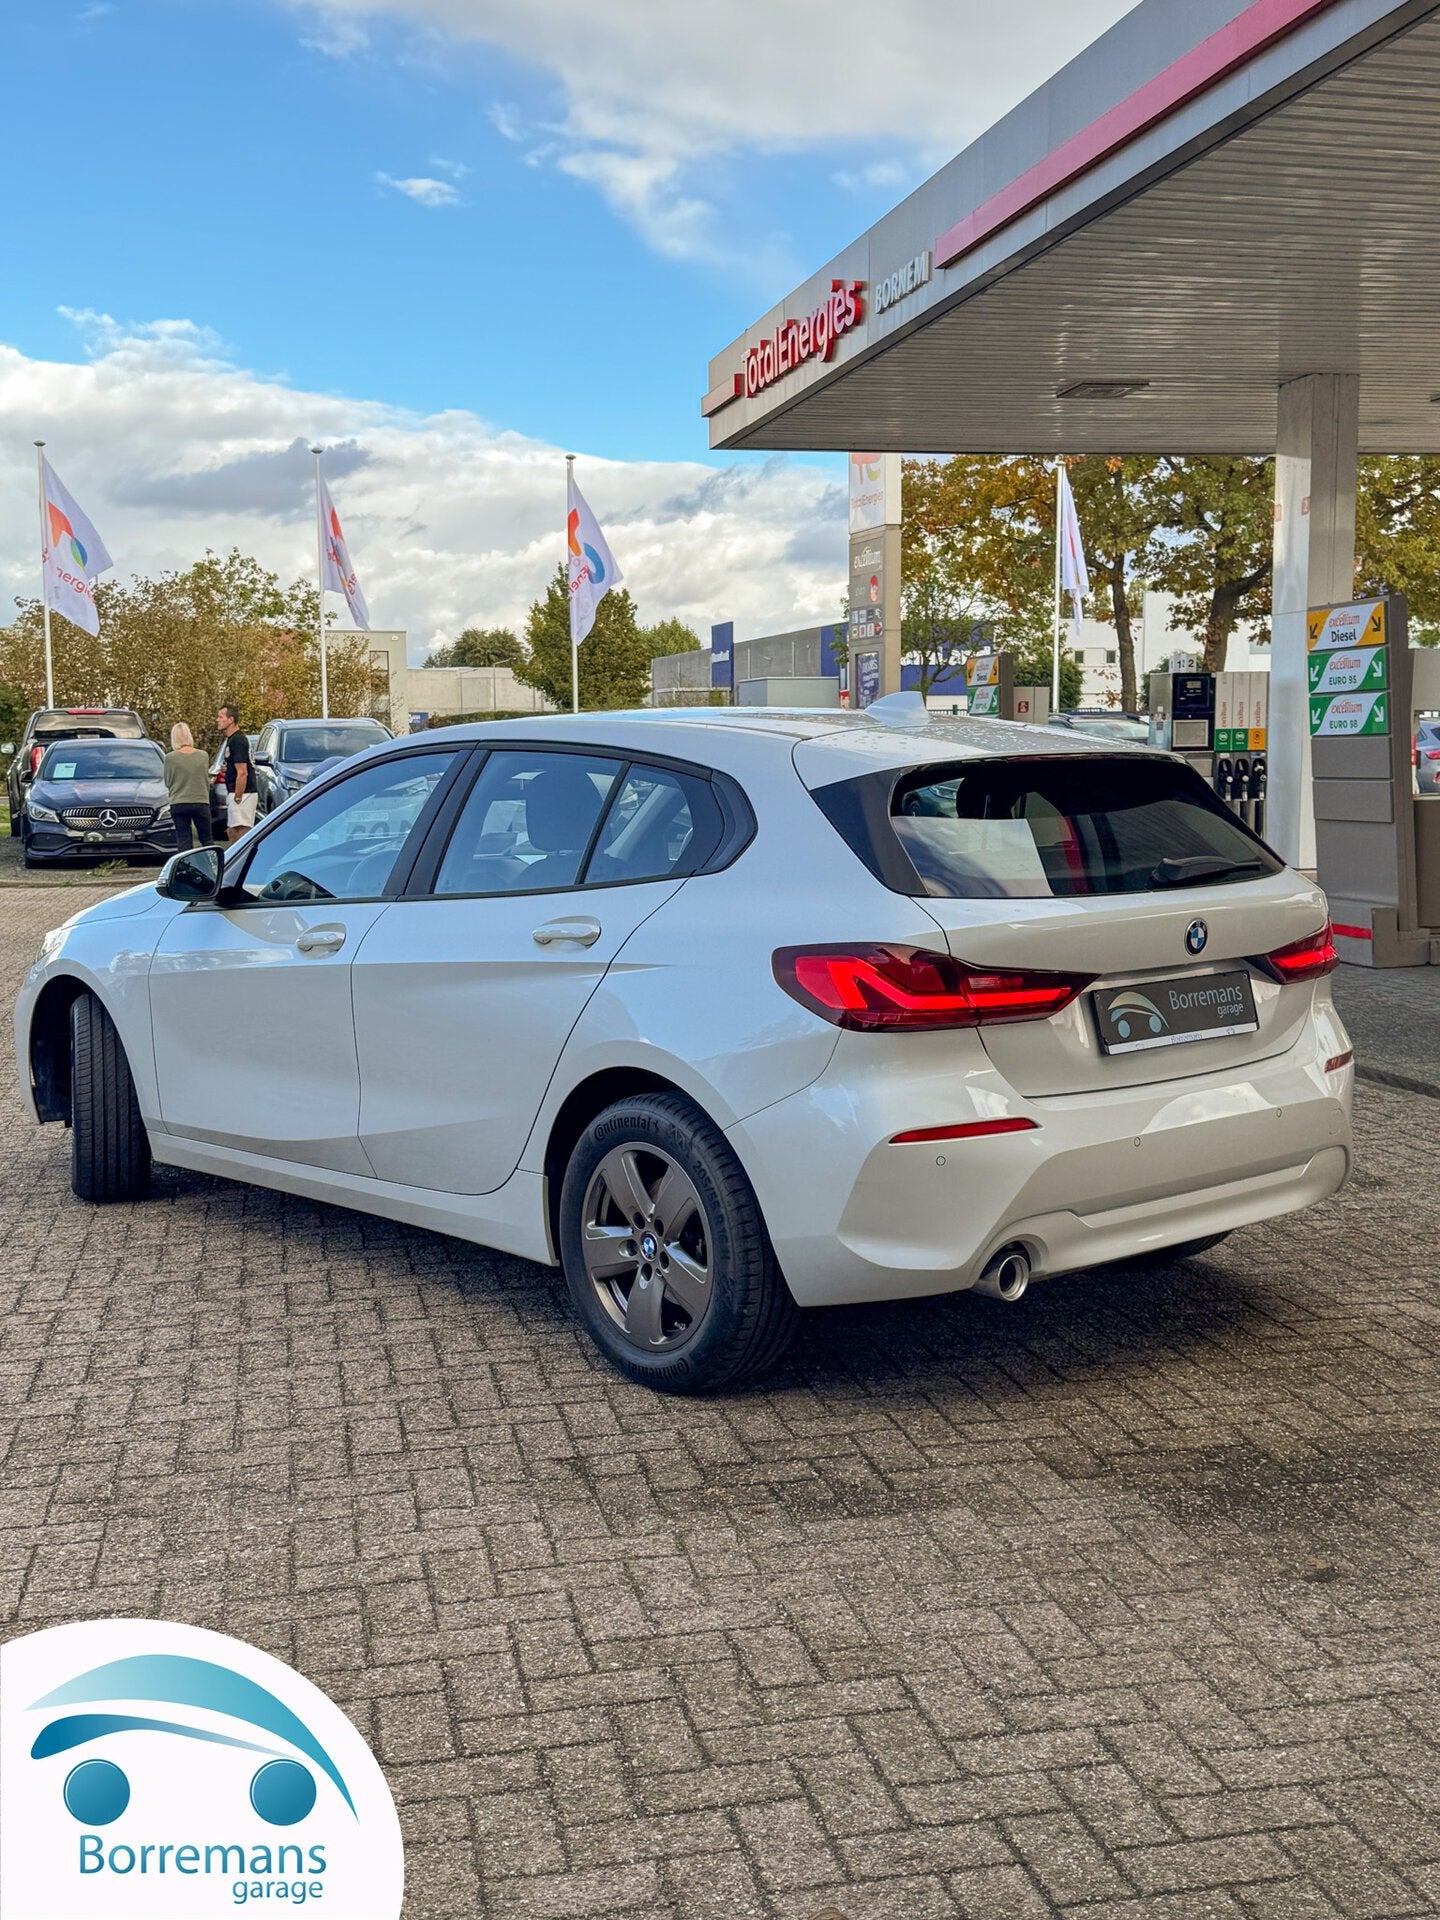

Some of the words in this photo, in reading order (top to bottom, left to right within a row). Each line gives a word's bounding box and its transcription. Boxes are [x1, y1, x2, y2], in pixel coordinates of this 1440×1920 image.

[875, 251, 932, 314] BORNEM
[741, 279, 863, 398] TotalEnergies
[1331, 628, 1357, 643] Diesel
[1188, 659, 1194, 668] 2
[1329, 676, 1347, 686] EURO
[1329, 719, 1348, 729] EURO
[1168, 985, 1243, 1010] Borremans
[1217, 1002, 1244, 1018] garage
[594, 1114, 652, 1141] Continental
[627, 1357, 691, 1381] Continental
